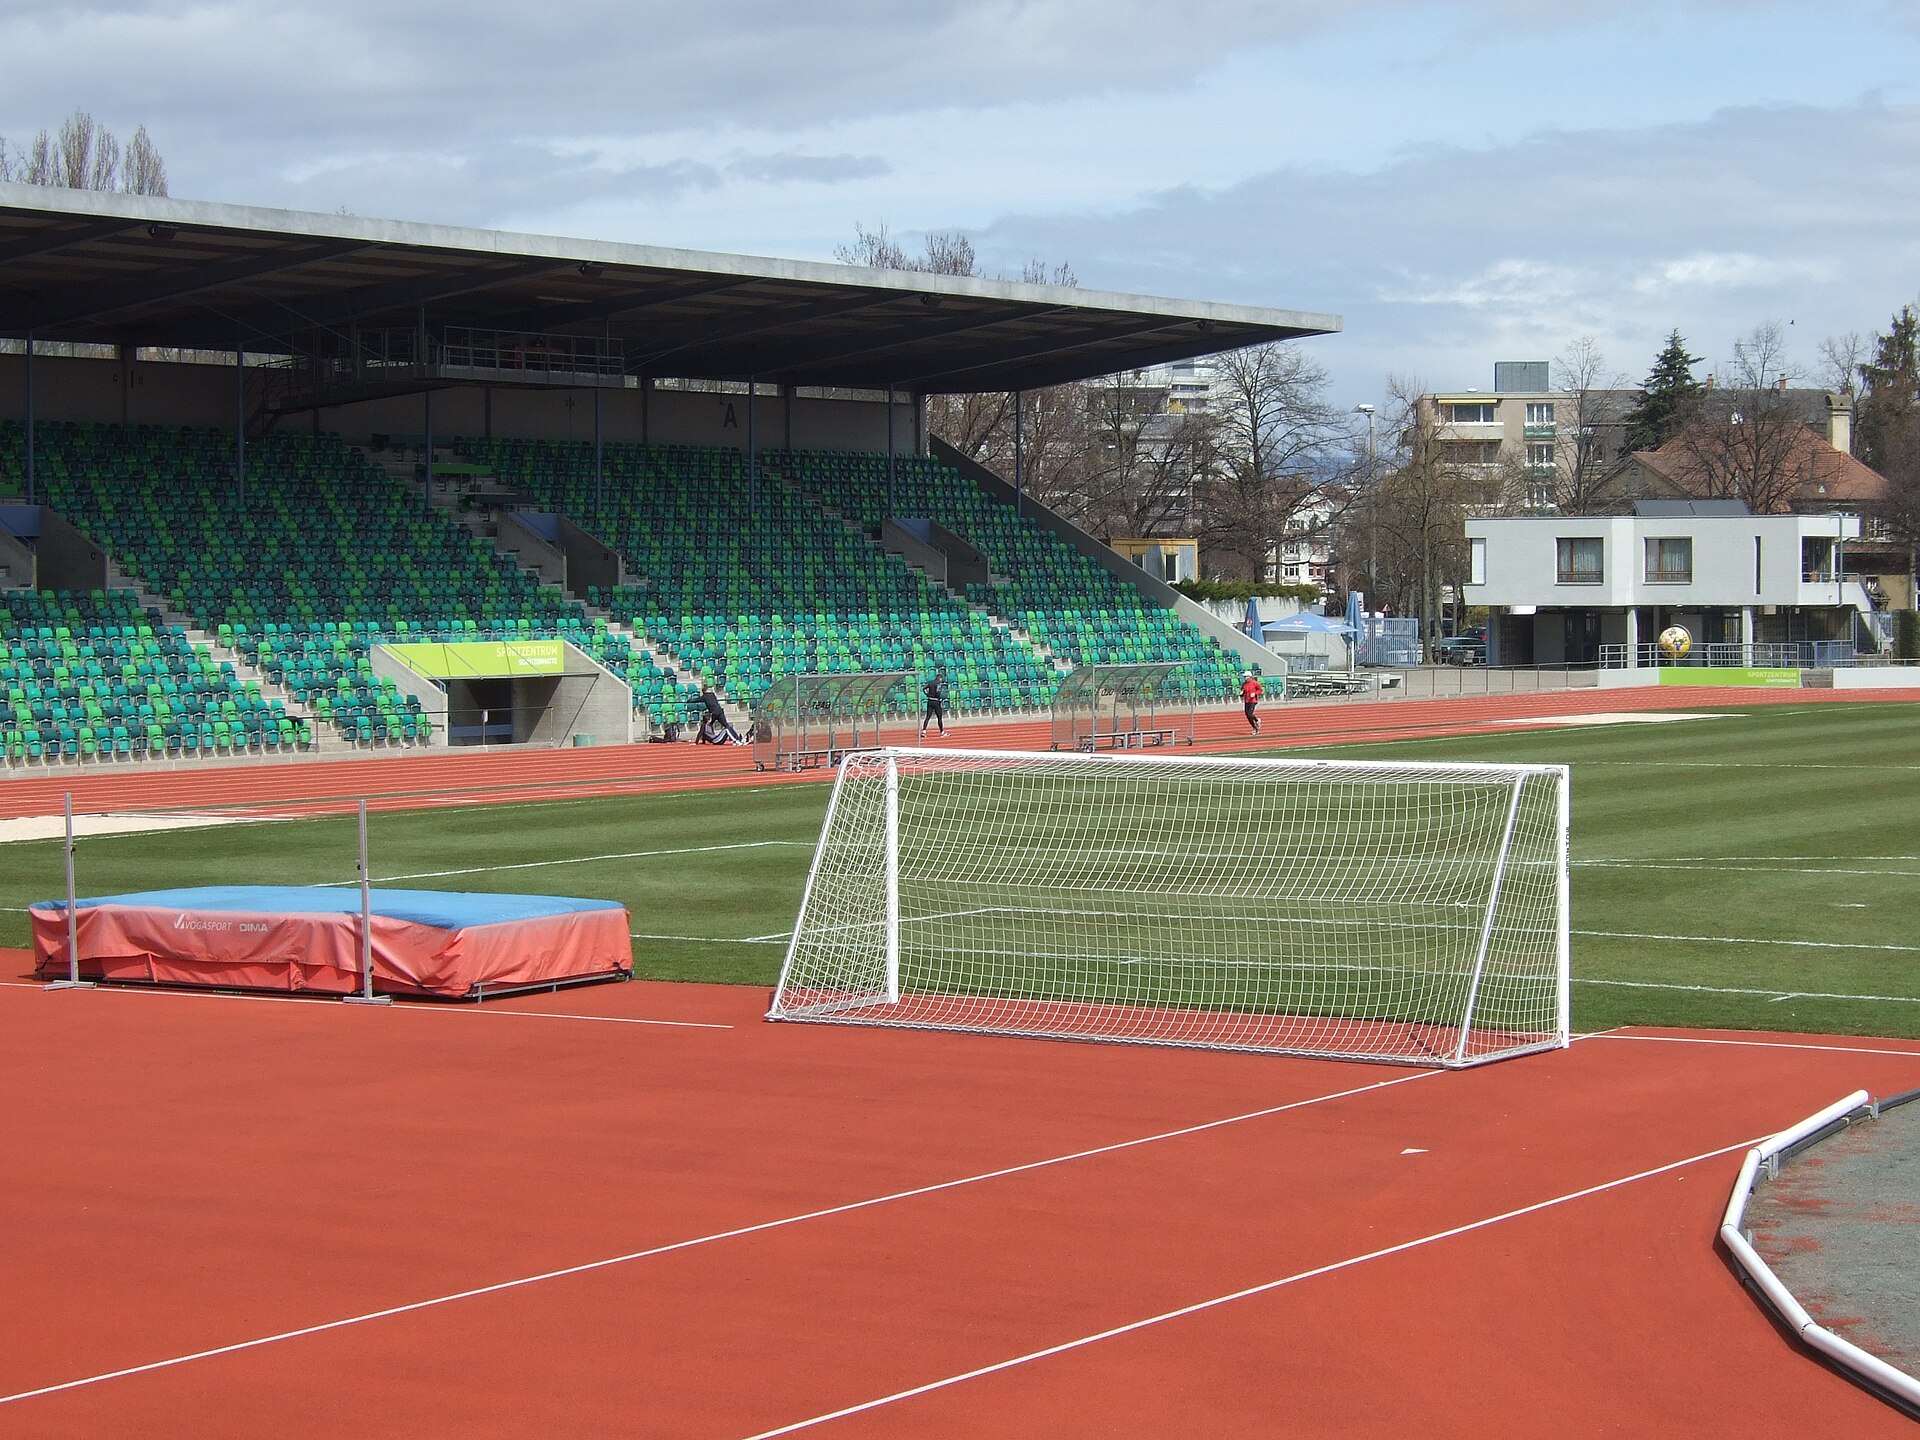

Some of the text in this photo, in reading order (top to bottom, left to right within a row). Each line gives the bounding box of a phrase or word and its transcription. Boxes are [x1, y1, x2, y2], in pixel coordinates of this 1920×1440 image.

[723, 402, 738, 428] A
[90, 551, 97, 560] C
[496, 645, 558, 658] SPORTZENTRUM
[239, 922, 268, 932] DIMA
